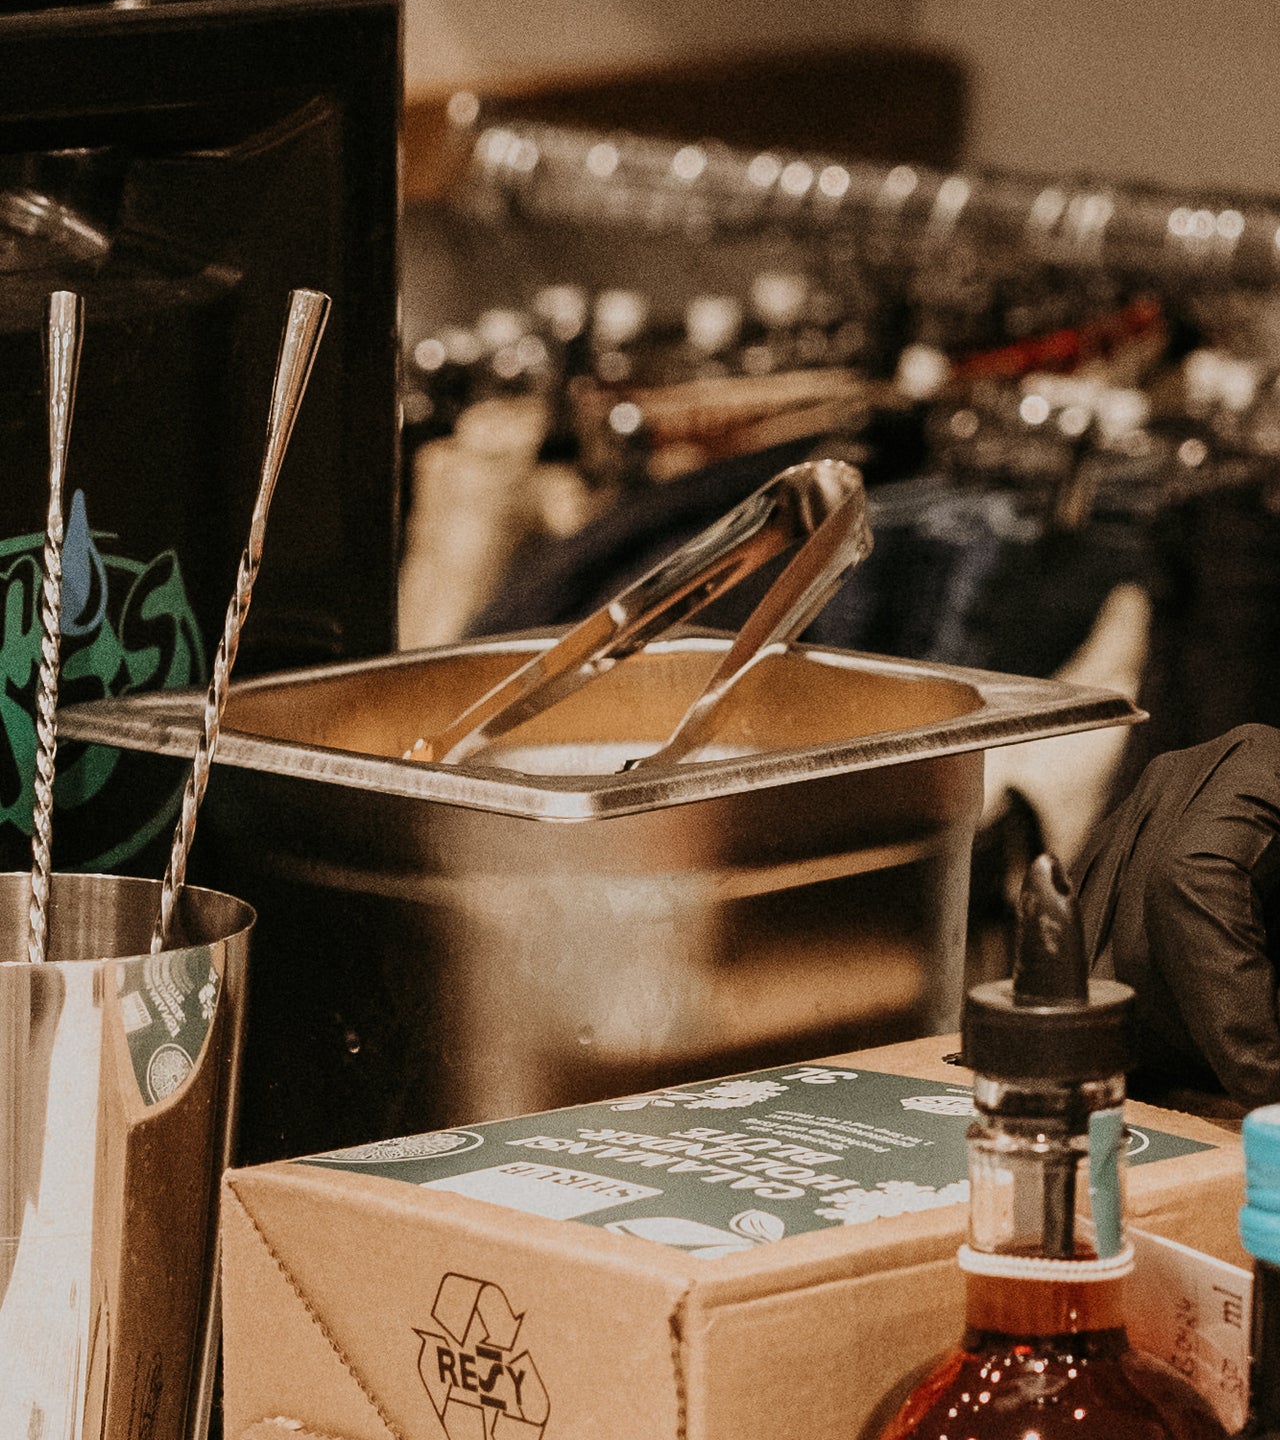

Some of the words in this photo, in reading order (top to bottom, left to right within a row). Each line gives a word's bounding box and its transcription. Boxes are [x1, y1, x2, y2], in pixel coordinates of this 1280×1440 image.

[782, 1067, 858, 1085] 3L
[505, 1135, 805, 1200] CALAMANSI
[436, 1345, 526, 1409] RESY
